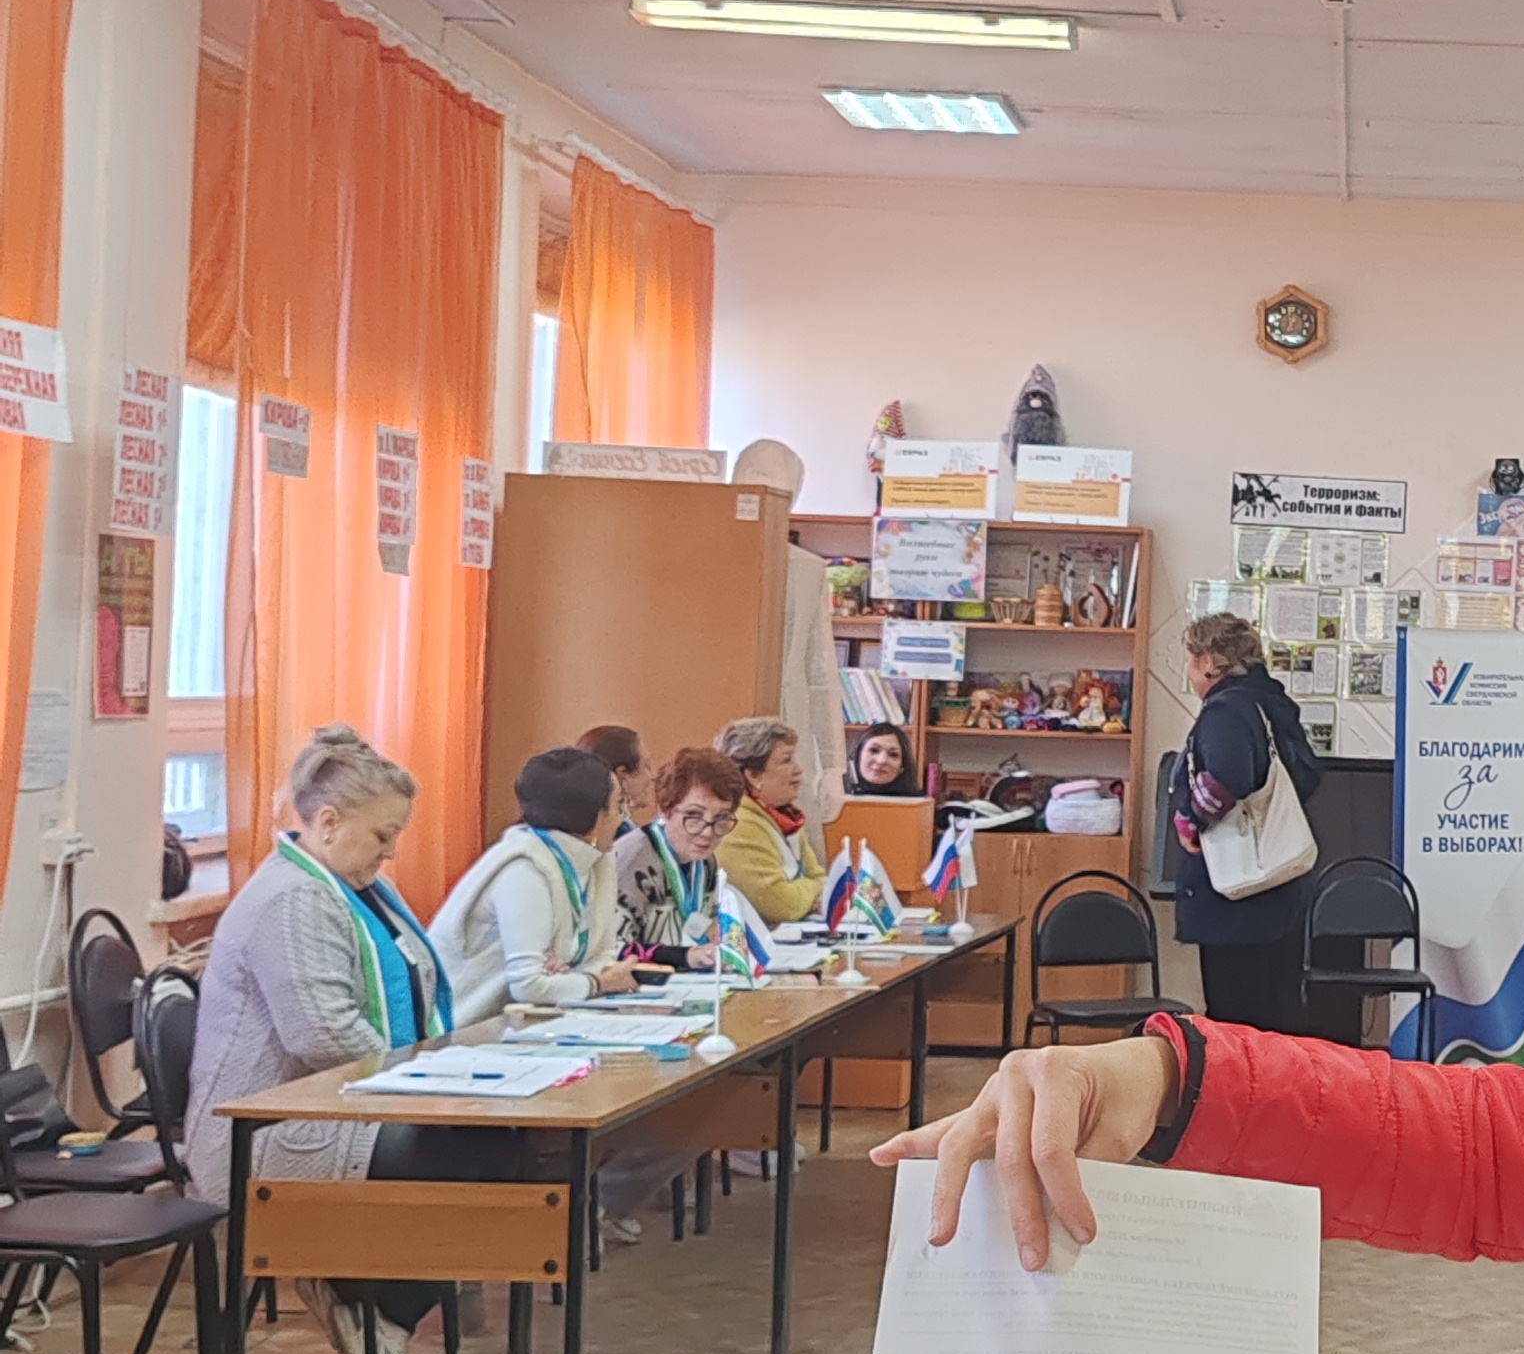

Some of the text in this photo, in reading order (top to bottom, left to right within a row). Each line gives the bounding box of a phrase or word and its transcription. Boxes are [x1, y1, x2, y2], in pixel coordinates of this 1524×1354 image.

[1282, 500, 1402, 519] события и факты
[1465, 690, 1518, 699] СВЕРДЛОВСКОЙ
[1470, 682, 1508, 690] КОМИССИЯ
[1461, 699, 1492, 707] ОБЛАСТИ
[1443, 763, 1499, 811] за
[1437, 813, 1510, 830] УЧАСТИЕ
[1422, 836, 1523, 853] В ВЫБОРАХ!
